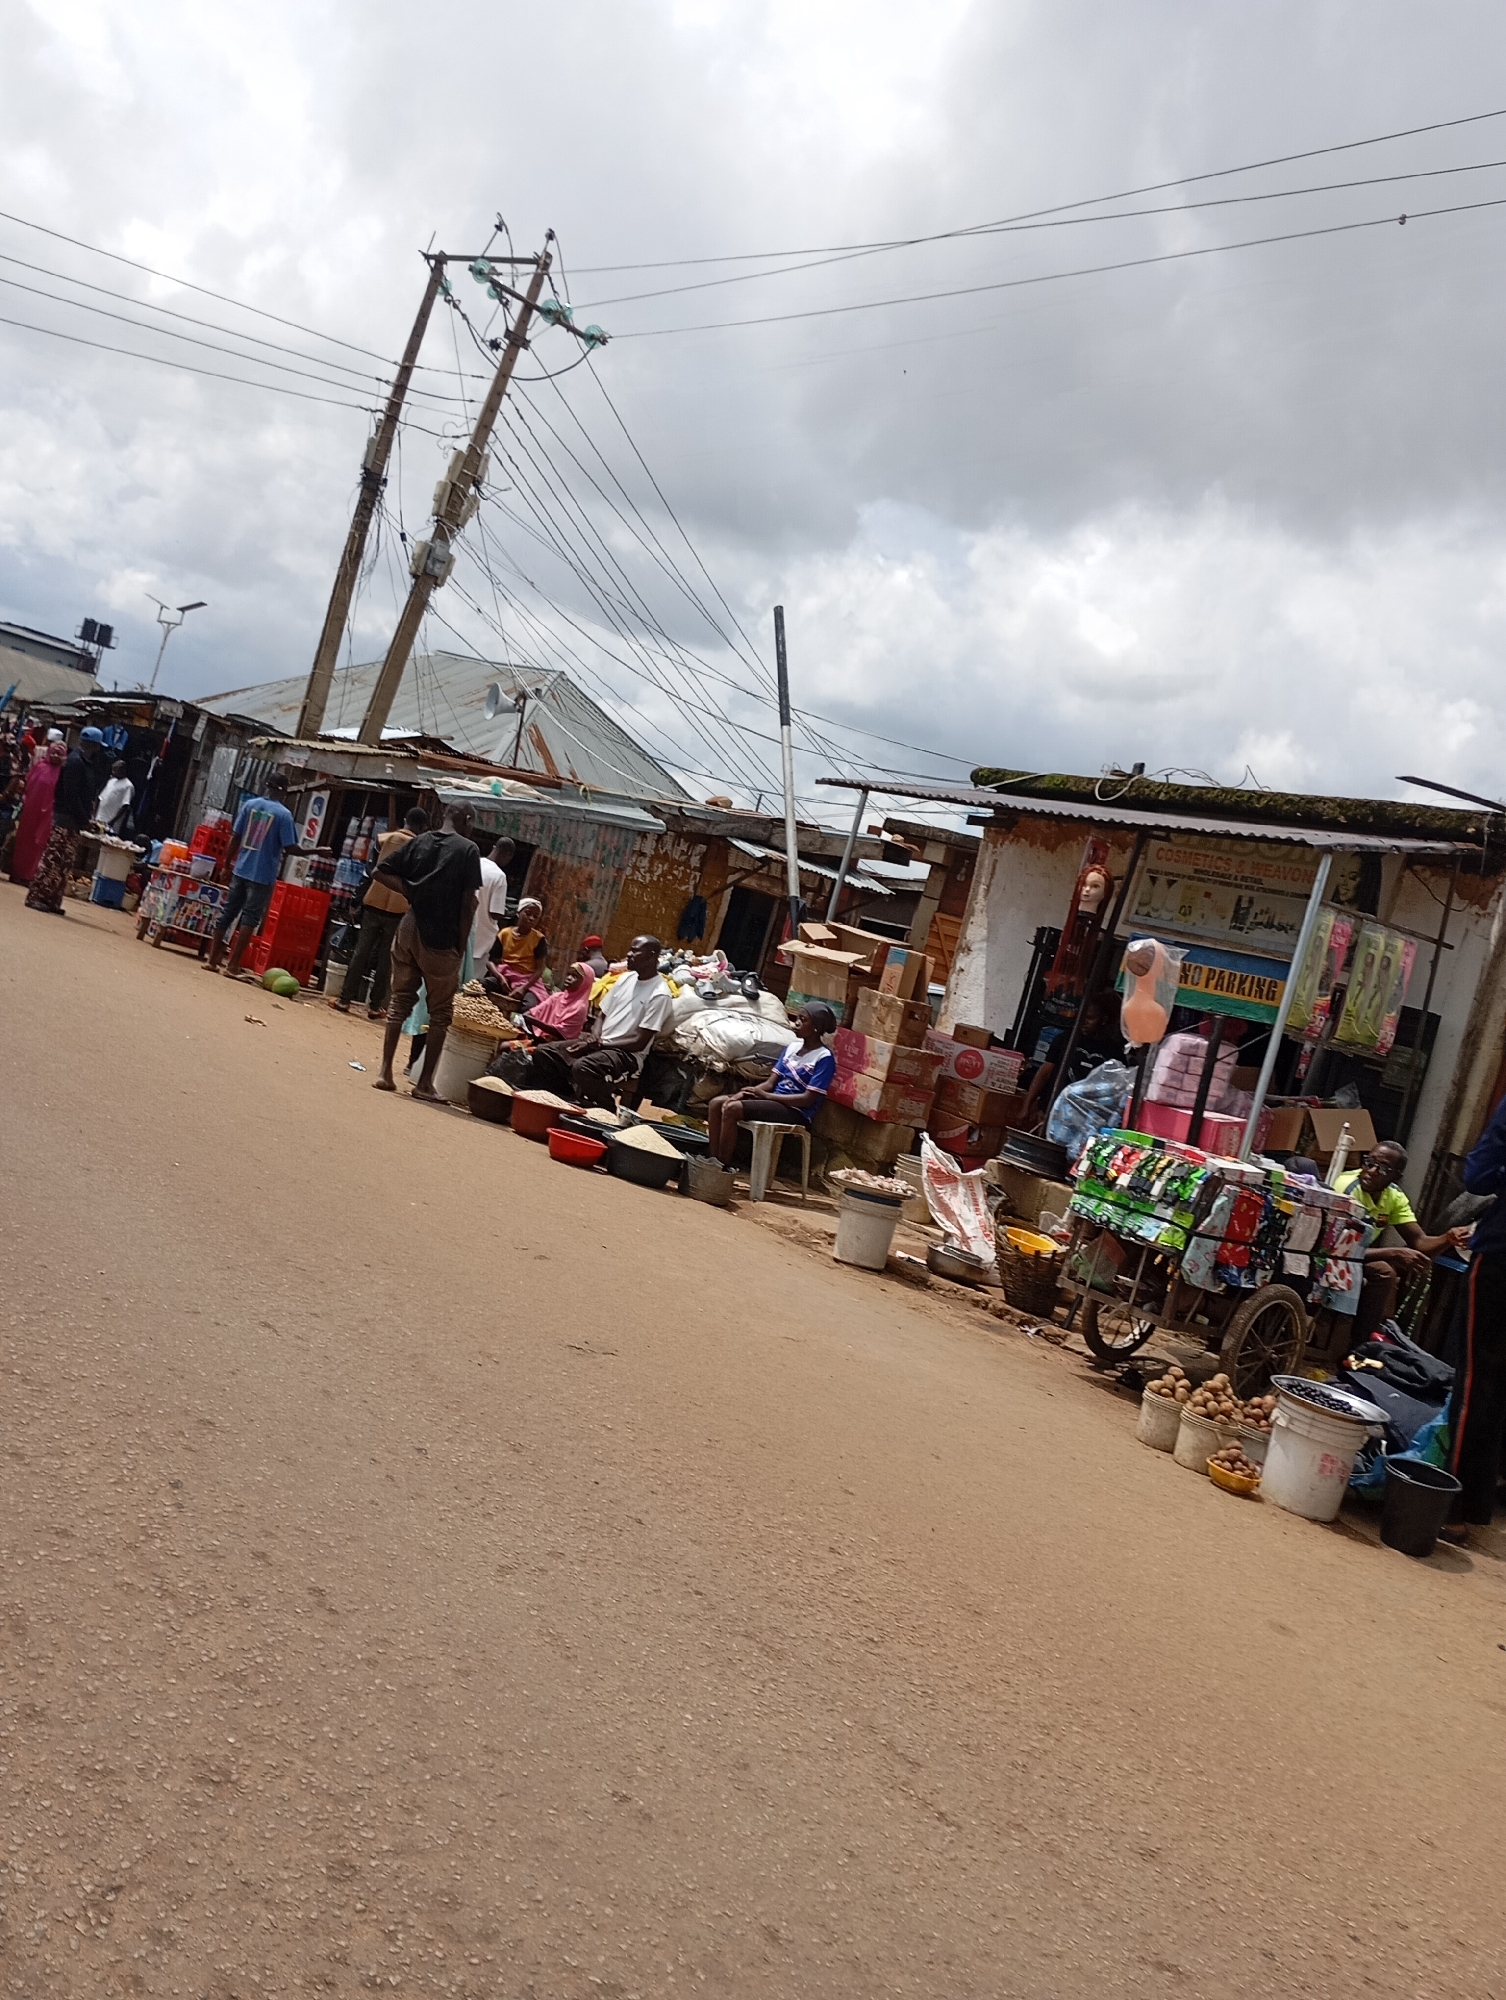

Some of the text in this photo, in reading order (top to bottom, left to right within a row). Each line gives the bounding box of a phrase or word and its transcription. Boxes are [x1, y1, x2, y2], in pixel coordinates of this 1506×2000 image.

[1156, 847, 1232, 872] COSMETICS
[1235, 859, 1246, 874] &
[1179, 963, 1278, 1002] NO PARKING
